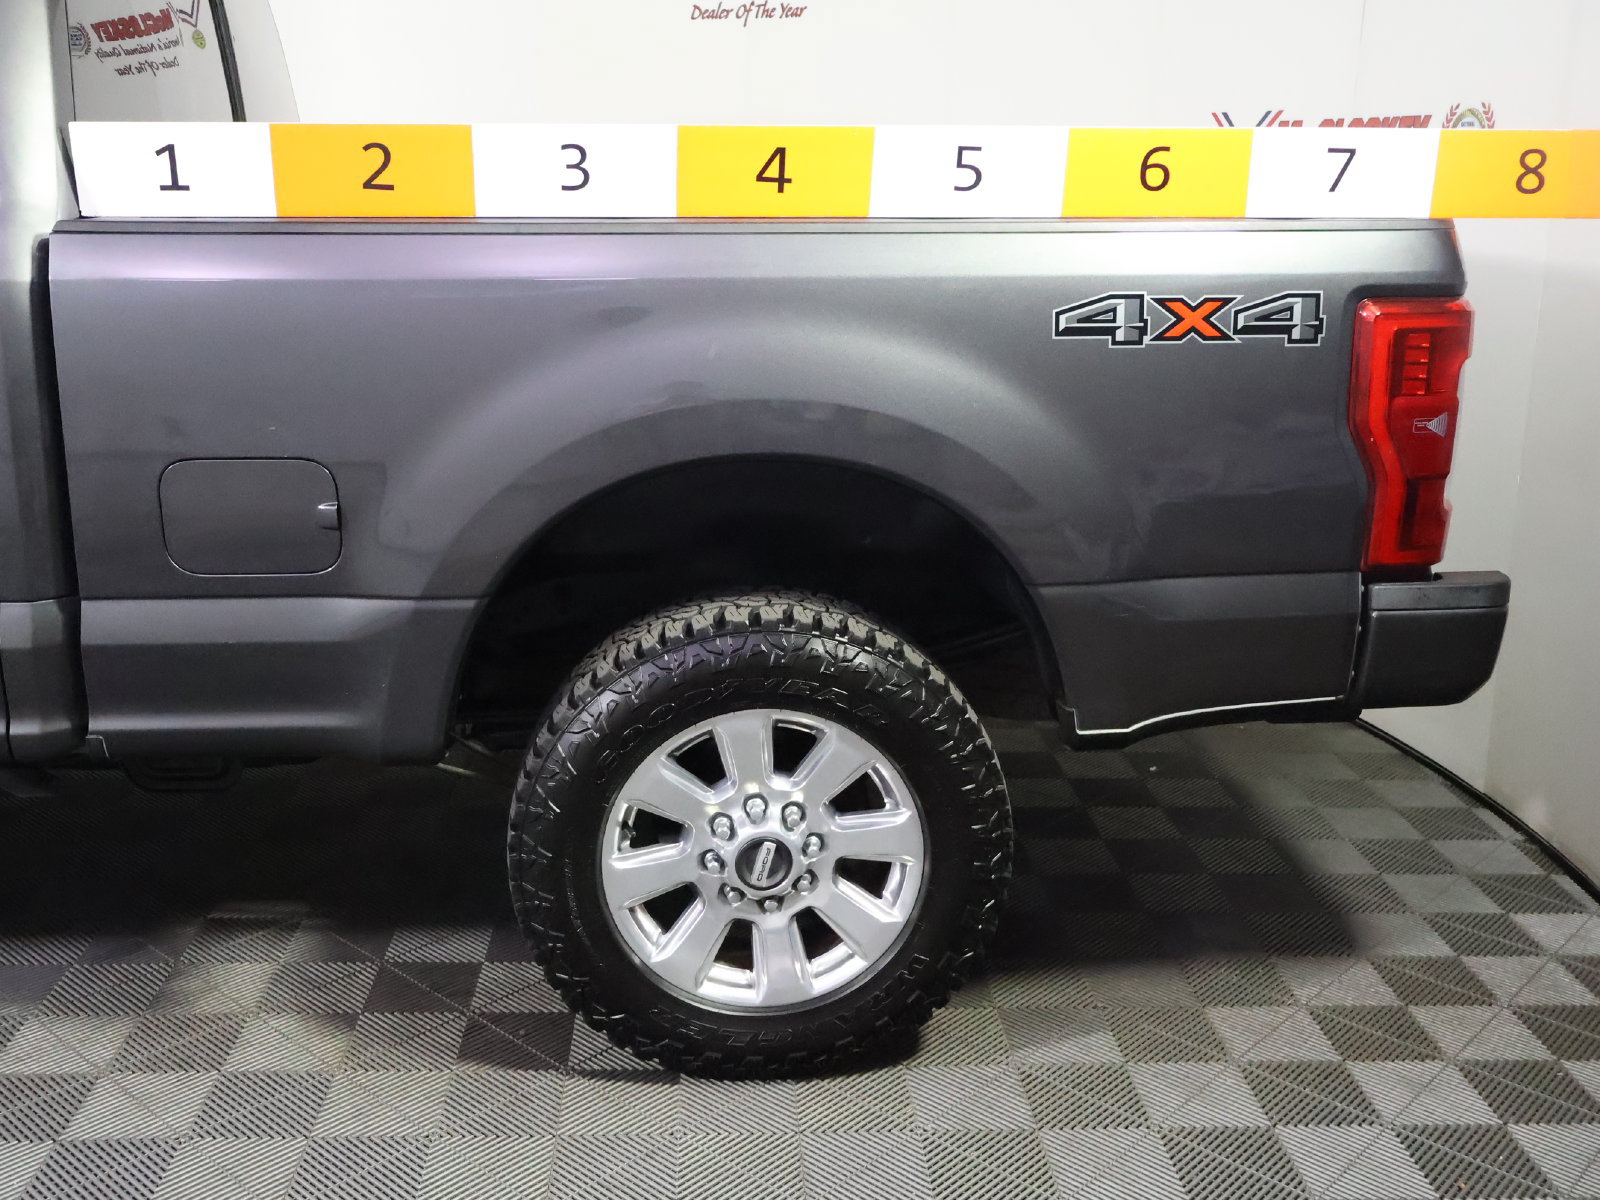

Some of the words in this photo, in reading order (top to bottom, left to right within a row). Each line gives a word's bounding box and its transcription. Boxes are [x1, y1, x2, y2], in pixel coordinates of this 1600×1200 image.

[690, 1, 734, 21] Dealer
[735, 0, 755, 27] Of
[755, 0, 777, 19] The
[779, 2, 808, 20] Year
[154, 143, 190, 191] 1
[362, 143, 395, 190] 2
[560, 143, 590, 191] 3
[755, 146, 793, 194] 4
[954, 145, 983, 192] 5
[1139, 146, 1171, 192] 6
[1327, 147, 1357, 193] 7
[1515, 148, 1547, 195] 8
[756, 847, 772, 882] FORD
